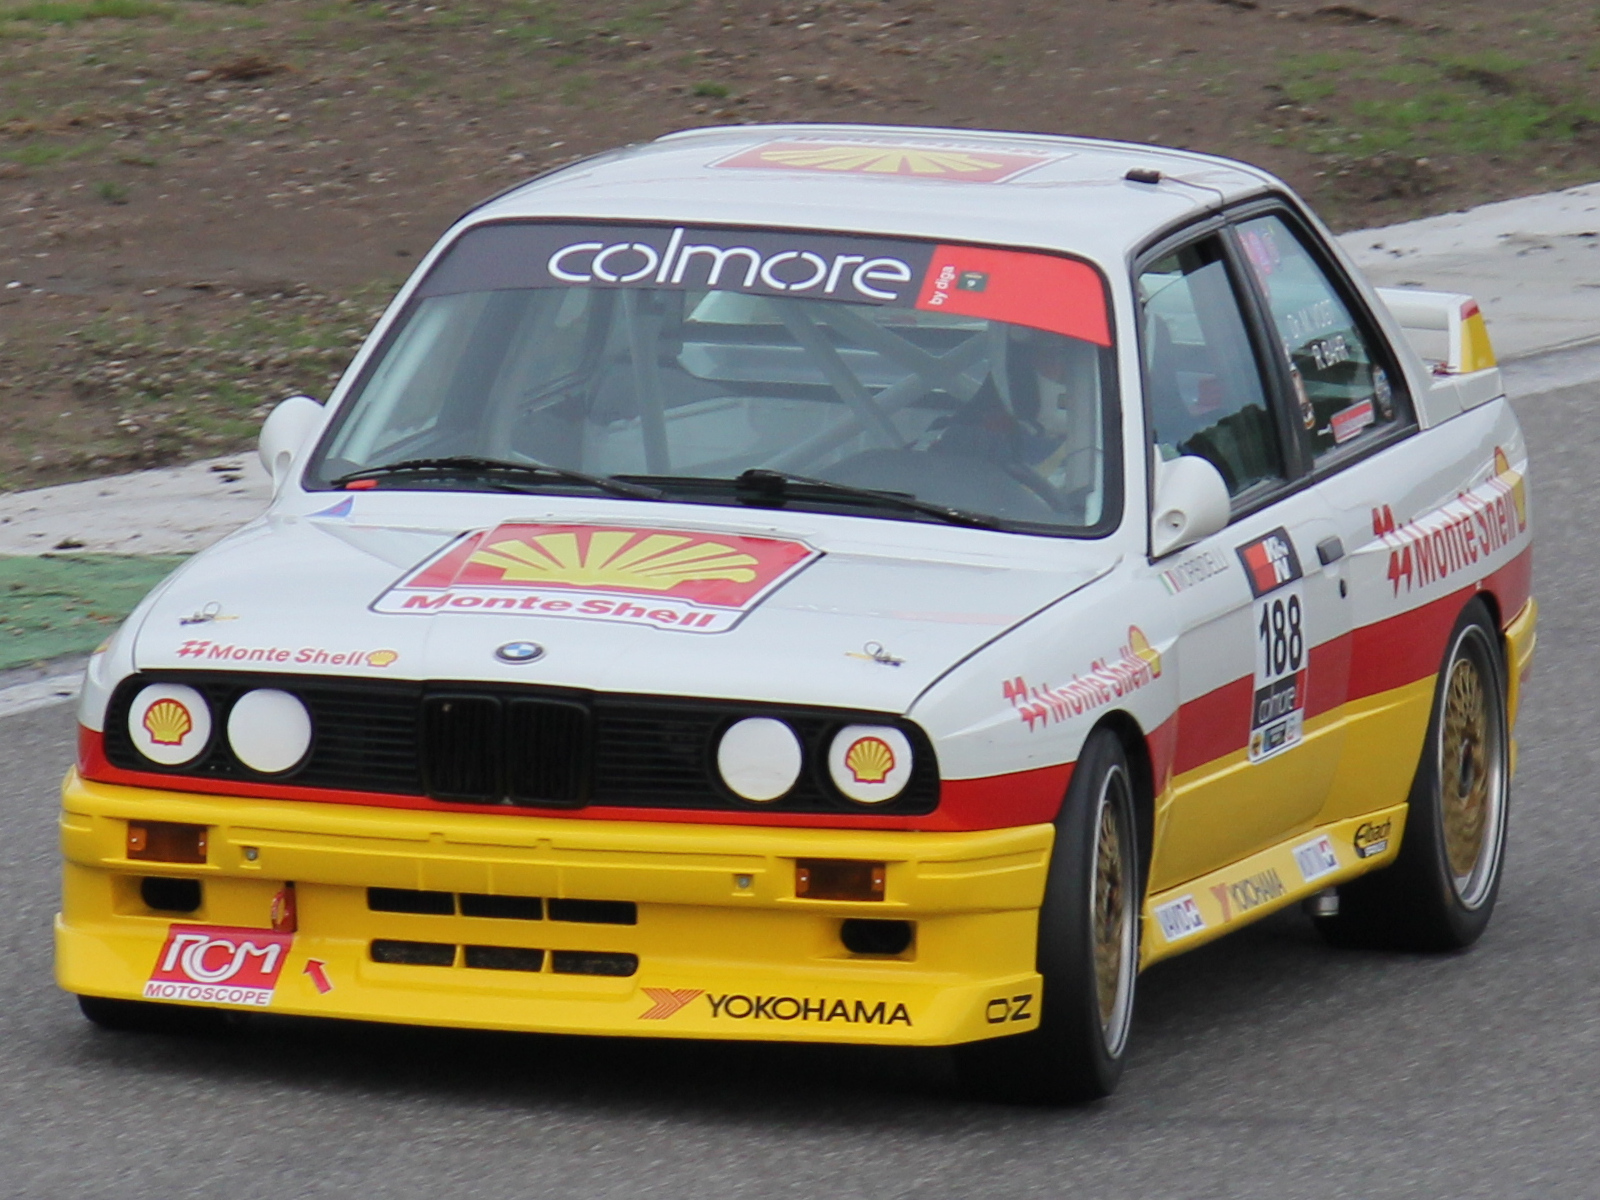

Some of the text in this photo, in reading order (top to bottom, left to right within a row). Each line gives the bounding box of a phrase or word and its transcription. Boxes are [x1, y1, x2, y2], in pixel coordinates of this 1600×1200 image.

[548, 227, 912, 301] colmore
[928, 265, 956, 305] by diga
[401, 592, 718, 628] Monte Shell
[1260, 594, 1303, 679] 188
[207, 643, 366, 666] Monte Shell
[144, 983, 271, 1005] MOTOSCOPE
[706, 993, 913, 1027] YOKOHAMA
[985, 994, 1033, 1024] OZ
